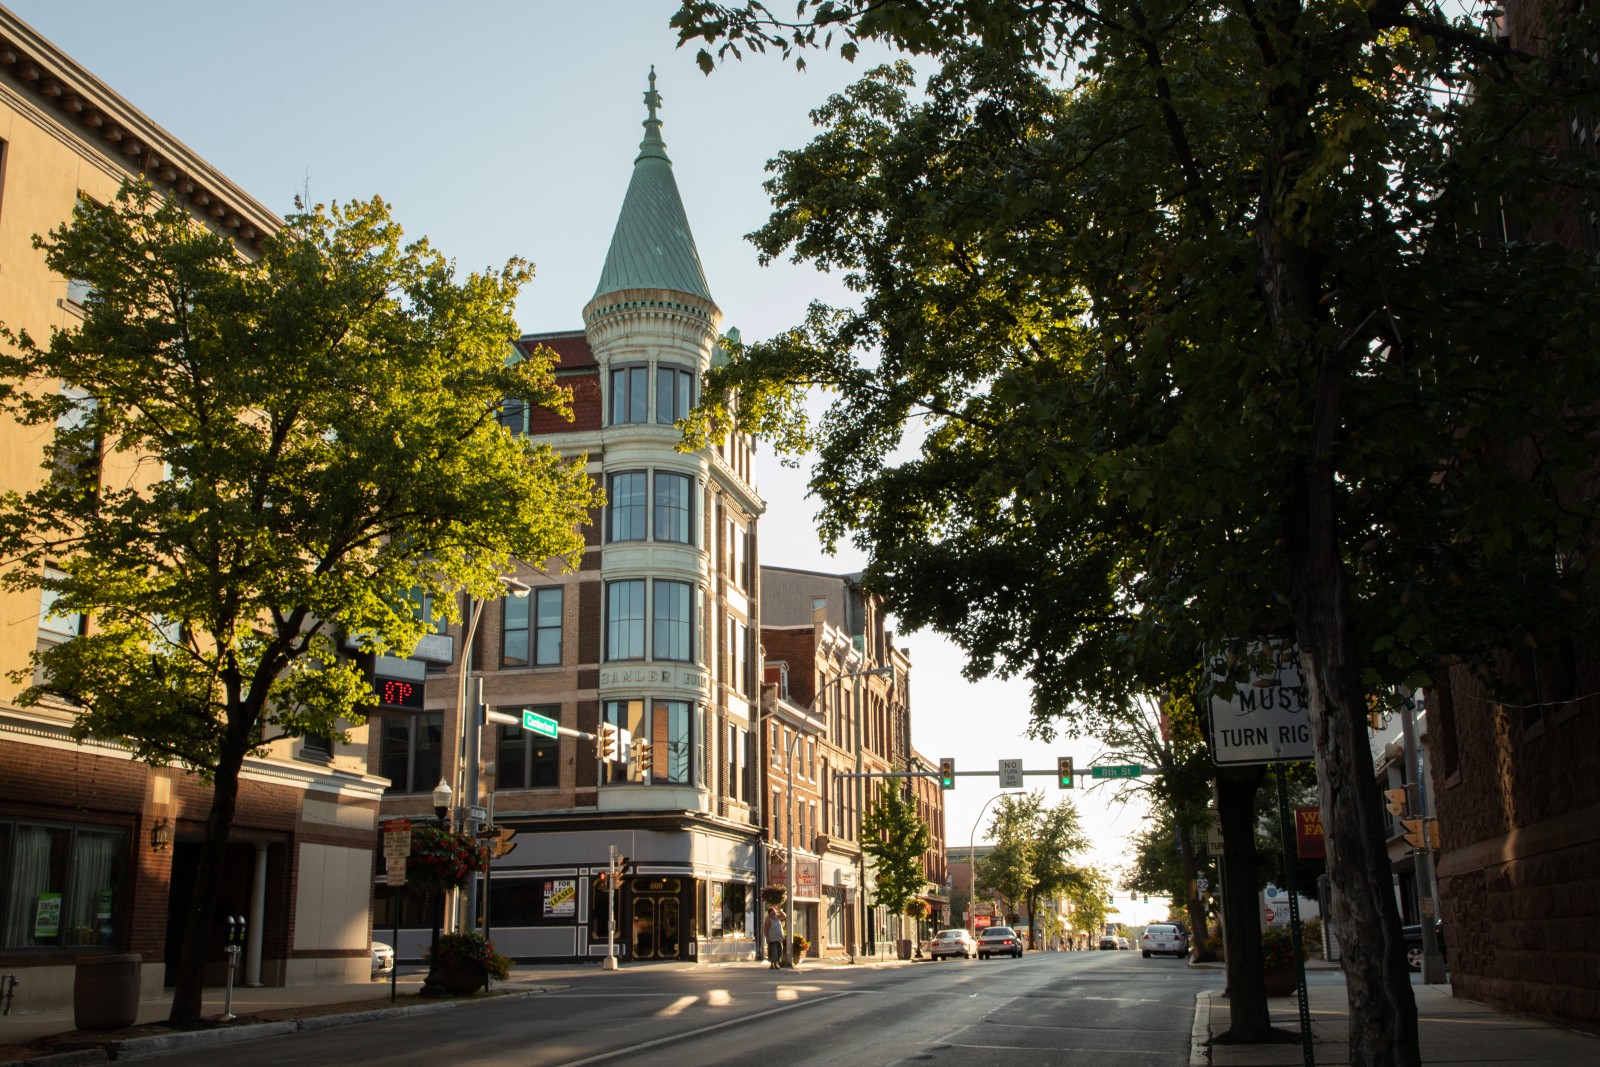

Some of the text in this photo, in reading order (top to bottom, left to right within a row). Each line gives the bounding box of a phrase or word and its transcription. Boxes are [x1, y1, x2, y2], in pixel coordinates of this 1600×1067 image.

[527, 715, 554, 734] Cumberland
[1220, 724, 1310, 747] TURN RIG
[1101, 767, 1132, 777] 8th St
[550, 887, 574, 906] LEASED
